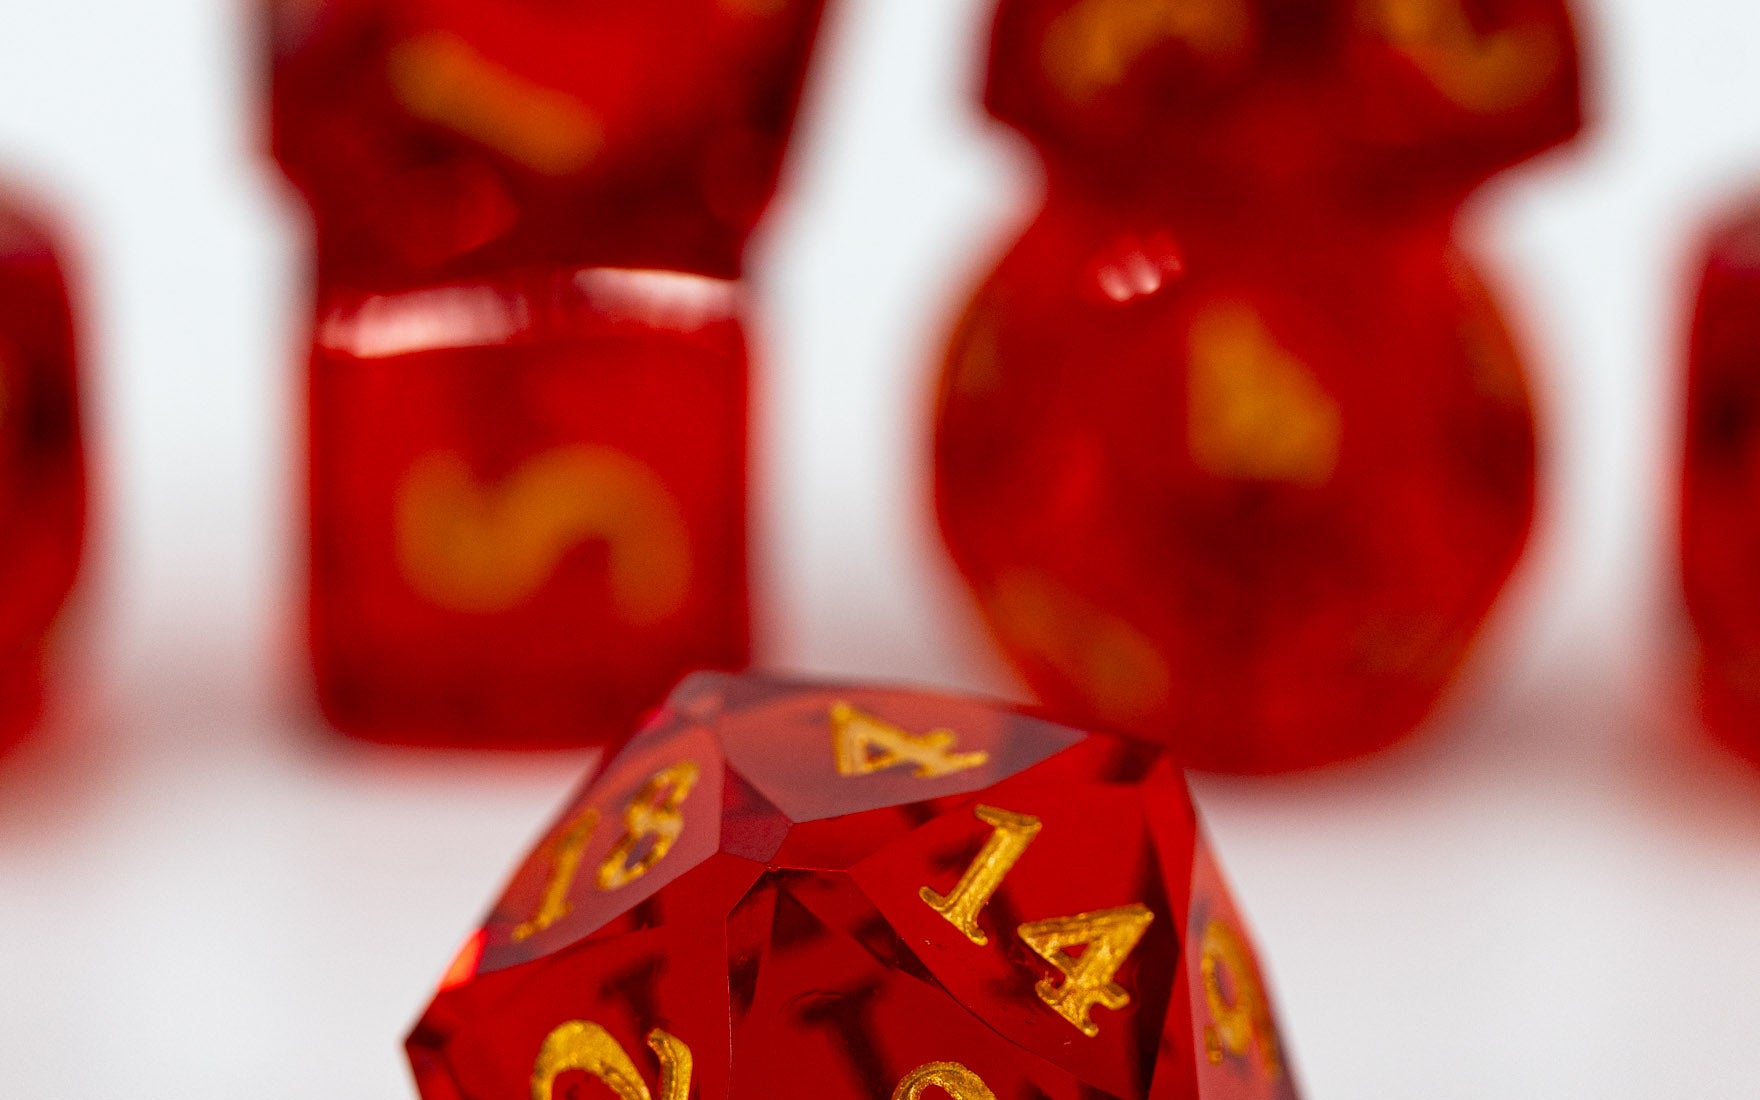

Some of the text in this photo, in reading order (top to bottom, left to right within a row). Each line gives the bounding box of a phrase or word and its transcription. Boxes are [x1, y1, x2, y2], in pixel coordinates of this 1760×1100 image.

[829, 700, 990, 780] 4
[510, 758, 698, 942] 18
[918, 803, 1156, 1039] 14
